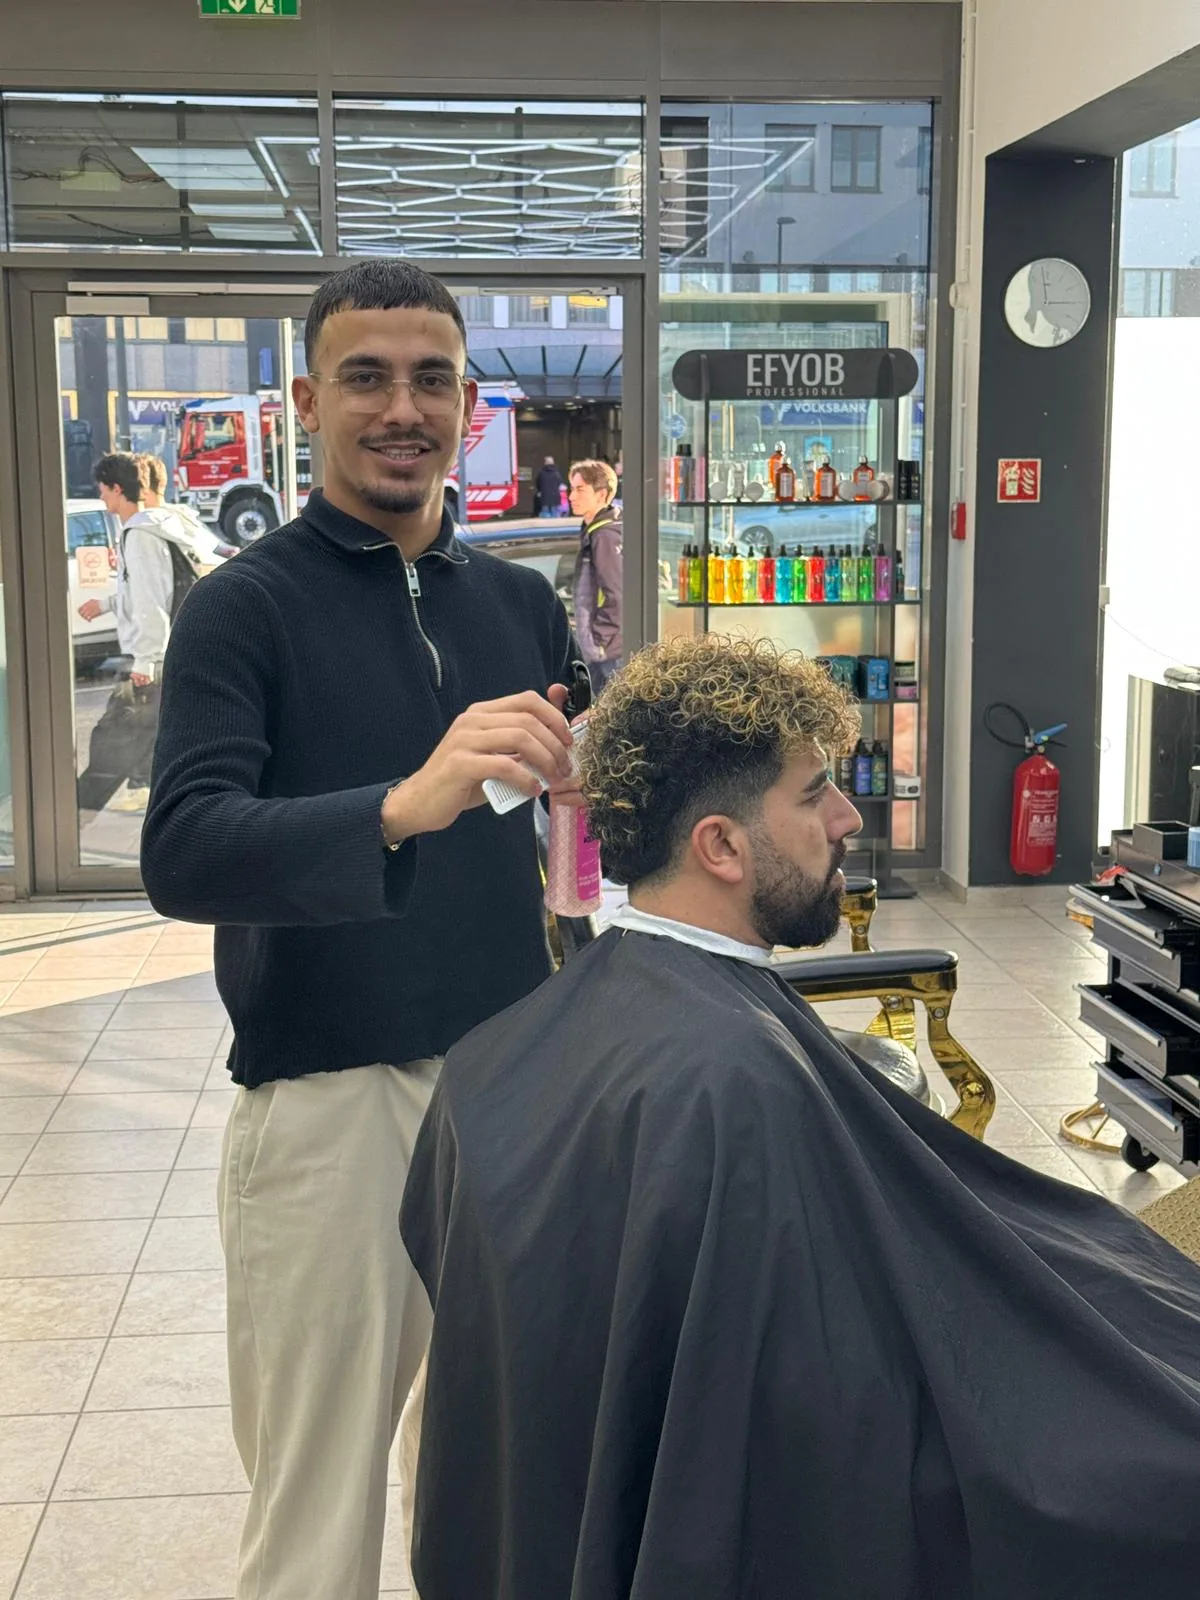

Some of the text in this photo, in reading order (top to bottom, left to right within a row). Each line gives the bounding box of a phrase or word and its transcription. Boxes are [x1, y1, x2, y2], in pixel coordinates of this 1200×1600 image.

[746, 353, 845, 386] EFYOB
[746, 387, 844, 397] PROFESSIONAL
[793, 403, 867, 413] VOLKSBANK
